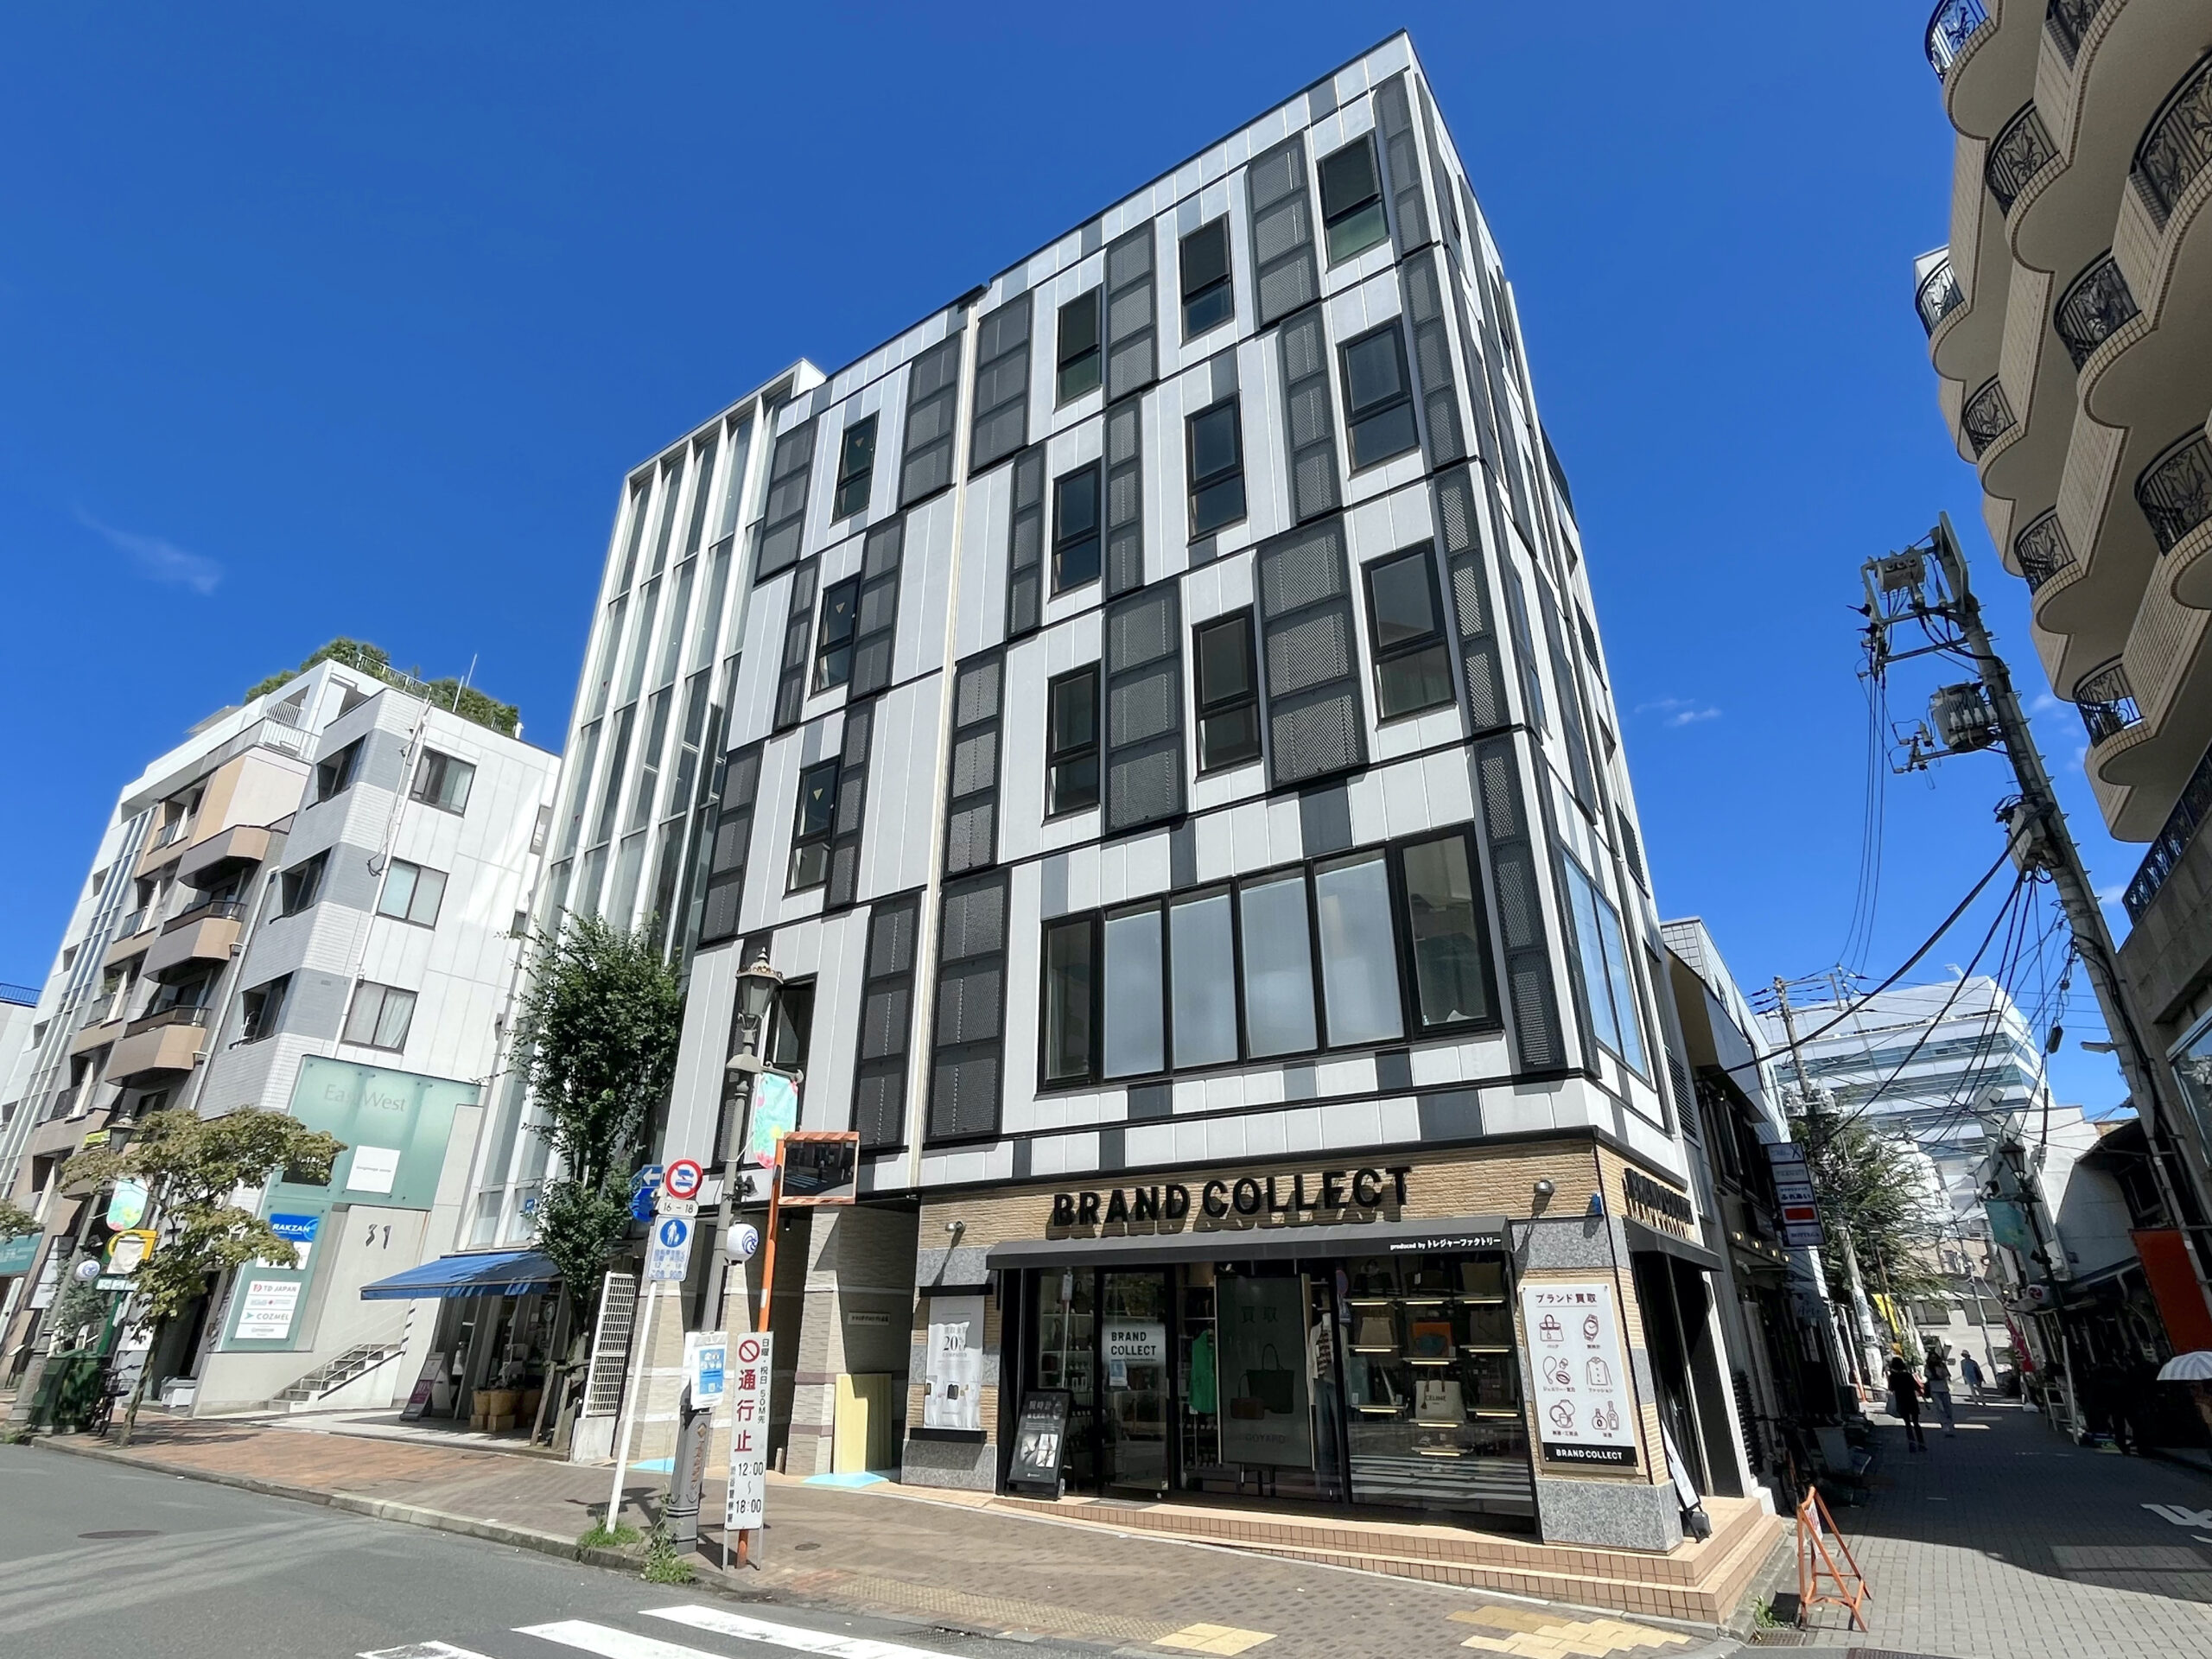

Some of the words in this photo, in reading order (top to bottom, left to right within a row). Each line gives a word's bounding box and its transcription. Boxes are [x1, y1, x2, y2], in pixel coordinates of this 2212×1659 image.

[363, 1089, 406, 1113] West
[1053, 1185, 1190, 1226] BRAND
[1202, 1166, 1412, 1217] COLLECT
[664, 1202, 672, 1212] 16
[684, 1204, 694, 1213] 18
[365, 1224, 391, 1249] 31
[1389, 1243, 1417, 1251] produced
[1427, 1236, 1502, 1249] トレジャーファクトリー
[1535, 1293, 1598, 1304] ブランド買取
[257, 1313, 289, 1321] COZMEL
[1111, 1332, 1147, 1341] BRAND
[1110, 1345, 1156, 1356] COLLECT
[734, 1369, 756, 1452] 通行止
[1556, 1448, 1585, 1459] BRAND
[1586, 1450, 1623, 1460] COLLECT
[738, 1461, 763, 1477] 12:00
[735, 1499, 761, 1514] 18:00
